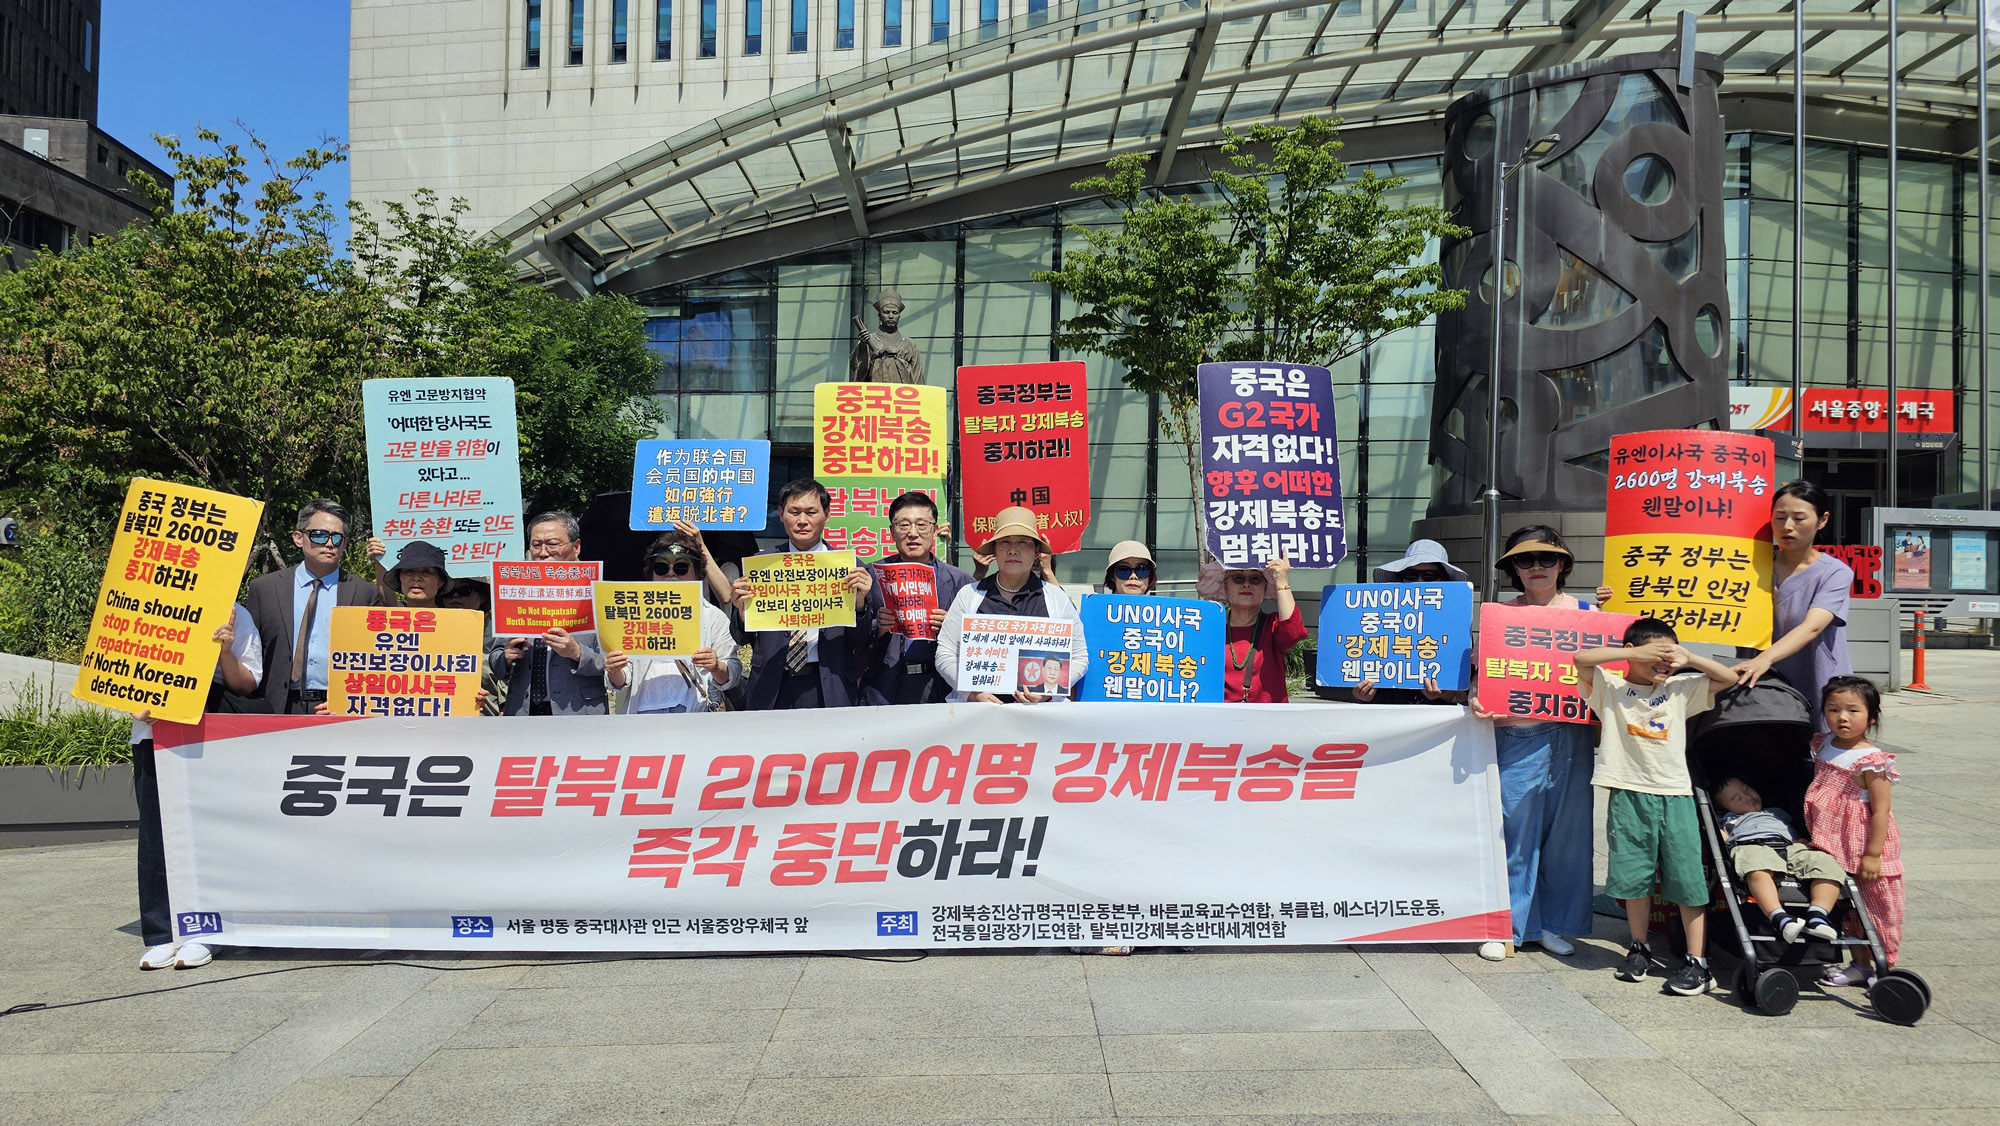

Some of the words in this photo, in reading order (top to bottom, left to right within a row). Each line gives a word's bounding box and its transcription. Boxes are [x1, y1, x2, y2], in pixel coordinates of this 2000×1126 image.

[976, 382, 1072, 405] 중국정부는
[1231, 368, 1310, 398] 중국은
[388, 390, 411, 402] 유엔
[415, 388, 486, 401] 고문방지협약
[836, 386, 921, 414] 중국은
[1218, 401, 1266, 428] G2
[1269, 401, 1320, 431] 국가
[1729, 404, 1750, 415] OST
[388, 416, 433, 432] '어떠한
[436, 415, 492, 431] 당사국도
[822, 416, 931, 444] 강제북송
[964, 415, 1017, 434] 탈북자
[1021, 410, 1084, 432] 강제북송
[384, 442, 417, 458] 고문
[420, 440, 453, 457] 받을
[455, 439, 500, 456] 위험이
[656, 448, 747, 466] 作为联合国
[984, 438, 1071, 463] 중지하라!
[1212, 434, 1333, 465] 자격없다!
[1614, 443, 1705, 465] 유엔이사국
[1711, 444, 1766, 467] 중국이
[822, 446, 939, 474] 중단하라!
[418, 467, 470, 482] 있다고...
[645, 468, 755, 485] 会员国的中国
[1207, 469, 1259, 497] 향후
[1263, 470, 1333, 496] 어떠한
[1614, 467, 1678, 490] 2600명
[1685, 469, 1768, 495] 강제북송
[398, 491, 431, 509] 다른
[1010, 486, 1050, 506] 中国
[138, 490, 166, 514] 중국
[171, 496, 227, 526] 정부는
[1209, 500, 1341, 531] 강제북송도
[1642, 496, 1733, 519] 웬말이냐!
[123, 512, 163, 537] 탈북민
[165, 521, 239, 552] 2600명
[453, 518, 480, 533] 또는
[484, 515, 515, 532] 인도
[133, 537, 200, 568] 강제북송
[452, 543, 468, 560] 안
[470, 541, 506, 559] 된다'
[1220, 533, 1334, 563] 멈춰라!!
[1622, 545, 1672, 567] 중국
[1680, 545, 1750, 570] 정부는
[783, 554, 815, 567] 중국은
[124, 559, 198, 591] 중지하라!
[500, 566, 541, 579] 탈북난민
[545, 566, 596, 580] 북송중지!
[749, 570, 771, 582] 유엔
[774, 567, 849, 582] 안전보장이사회
[614, 591, 639, 605] 중국
[644, 591, 681, 605] 정부는
[806, 584, 827, 596] 자격
[899, 581, 917, 595] 시민
[1345, 587, 1444, 610] UN이사국
[1628, 575, 1698, 598] 탈북민
[1707, 578, 1750, 602] 인권
[106, 589, 139, 612] China
[143, 599, 202, 624] should
[517, 606, 526, 615] Do
[528, 607, 540, 615] Not
[605, 607, 641, 620] 탈북민
[646, 607, 692, 620] 2600명
[756, 600, 787, 612] 안보리
[791, 596, 843, 612] 상임이사국
[103, 613, 129, 635] stop
[133, 618, 191, 644] forced
[366, 610, 436, 632] 중국은
[506, 617, 525, 625] North
[527, 618, 550, 626] Korean
[553, 616, 589, 627] Refugees!
[623, 622, 674, 635] 강제북송
[779, 614, 825, 627] 사퇴하라!
[970, 620, 995, 630] 중국은
[997, 621, 1008, 630] G2
[1011, 621, 1028, 632] 국가
[1030, 622, 1046, 633] 자격
[1048, 624, 1067, 634] 없다!
[1106, 604, 1202, 631] UN이사국
[1360, 611, 1424, 634] 중국이
[96, 634, 185, 665] repatriation
[375, 632, 420, 652] 유엔
[622, 637, 676, 650] 중지하라!
[962, 633, 970, 642] 전
[973, 633, 989, 643] 세계
[991, 634, 1006, 644] 시민
[1009, 635, 1032, 646] 앞에서
[1035, 636, 1070, 648] 사과하라!
[1122, 627, 1184, 653] 중국이
[332, 652, 477, 673] 안전보장이사회
[966, 646, 982, 657] 향후
[985, 647, 1009, 658] 어떠한
[83, 652, 94, 667] of
[94, 653, 129, 676] North
[133, 663, 198, 690] Korean
[965, 661, 1006, 672] 강제북송도
[1341, 660, 1441, 684] 웬말이냐?
[1486, 657, 1552, 682] 탈북자
[91, 675, 169, 707] defectors!
[344, 673, 456, 695] 상임이사국
[1103, 675, 1200, 703] 웬말이냐?
[347, 696, 451, 716] 자격없다!
[280, 755, 474, 817] 중국은
[490, 754, 686, 818] 탈북민
[698, 742, 1038, 811] 2600여명
[1052, 742, 1369, 804] 강제북송을
[628, 825, 759, 889] 즉각
[770, 816, 1049, 887] 중단하라!
[932, 904, 1144, 922] 강제북송진상규명국민운동본부,
[1150, 902, 1275, 920] 바른교육교수연합,
[1278, 901, 1328, 918] 북클럽,
[1333, 899, 1446, 918] 에스더기도운동,
[182, 914, 218, 933] 일시
[457, 918, 491, 935] 장소
[506, 918, 536, 934] 서울
[540, 918, 569, 935] 명동
[574, 918, 647, 935] 중국대사관
[651, 918, 681, 935] 인근
[686, 918, 789, 935] 서울중앙우체국
[793, 917, 809, 934] 앞
[880, 915, 914, 933] 주최
[932, 923, 1085, 941] 전국통일광장기도연합,
[1090, 920, 1286, 940] 탈북민강제북송반대세계연합
